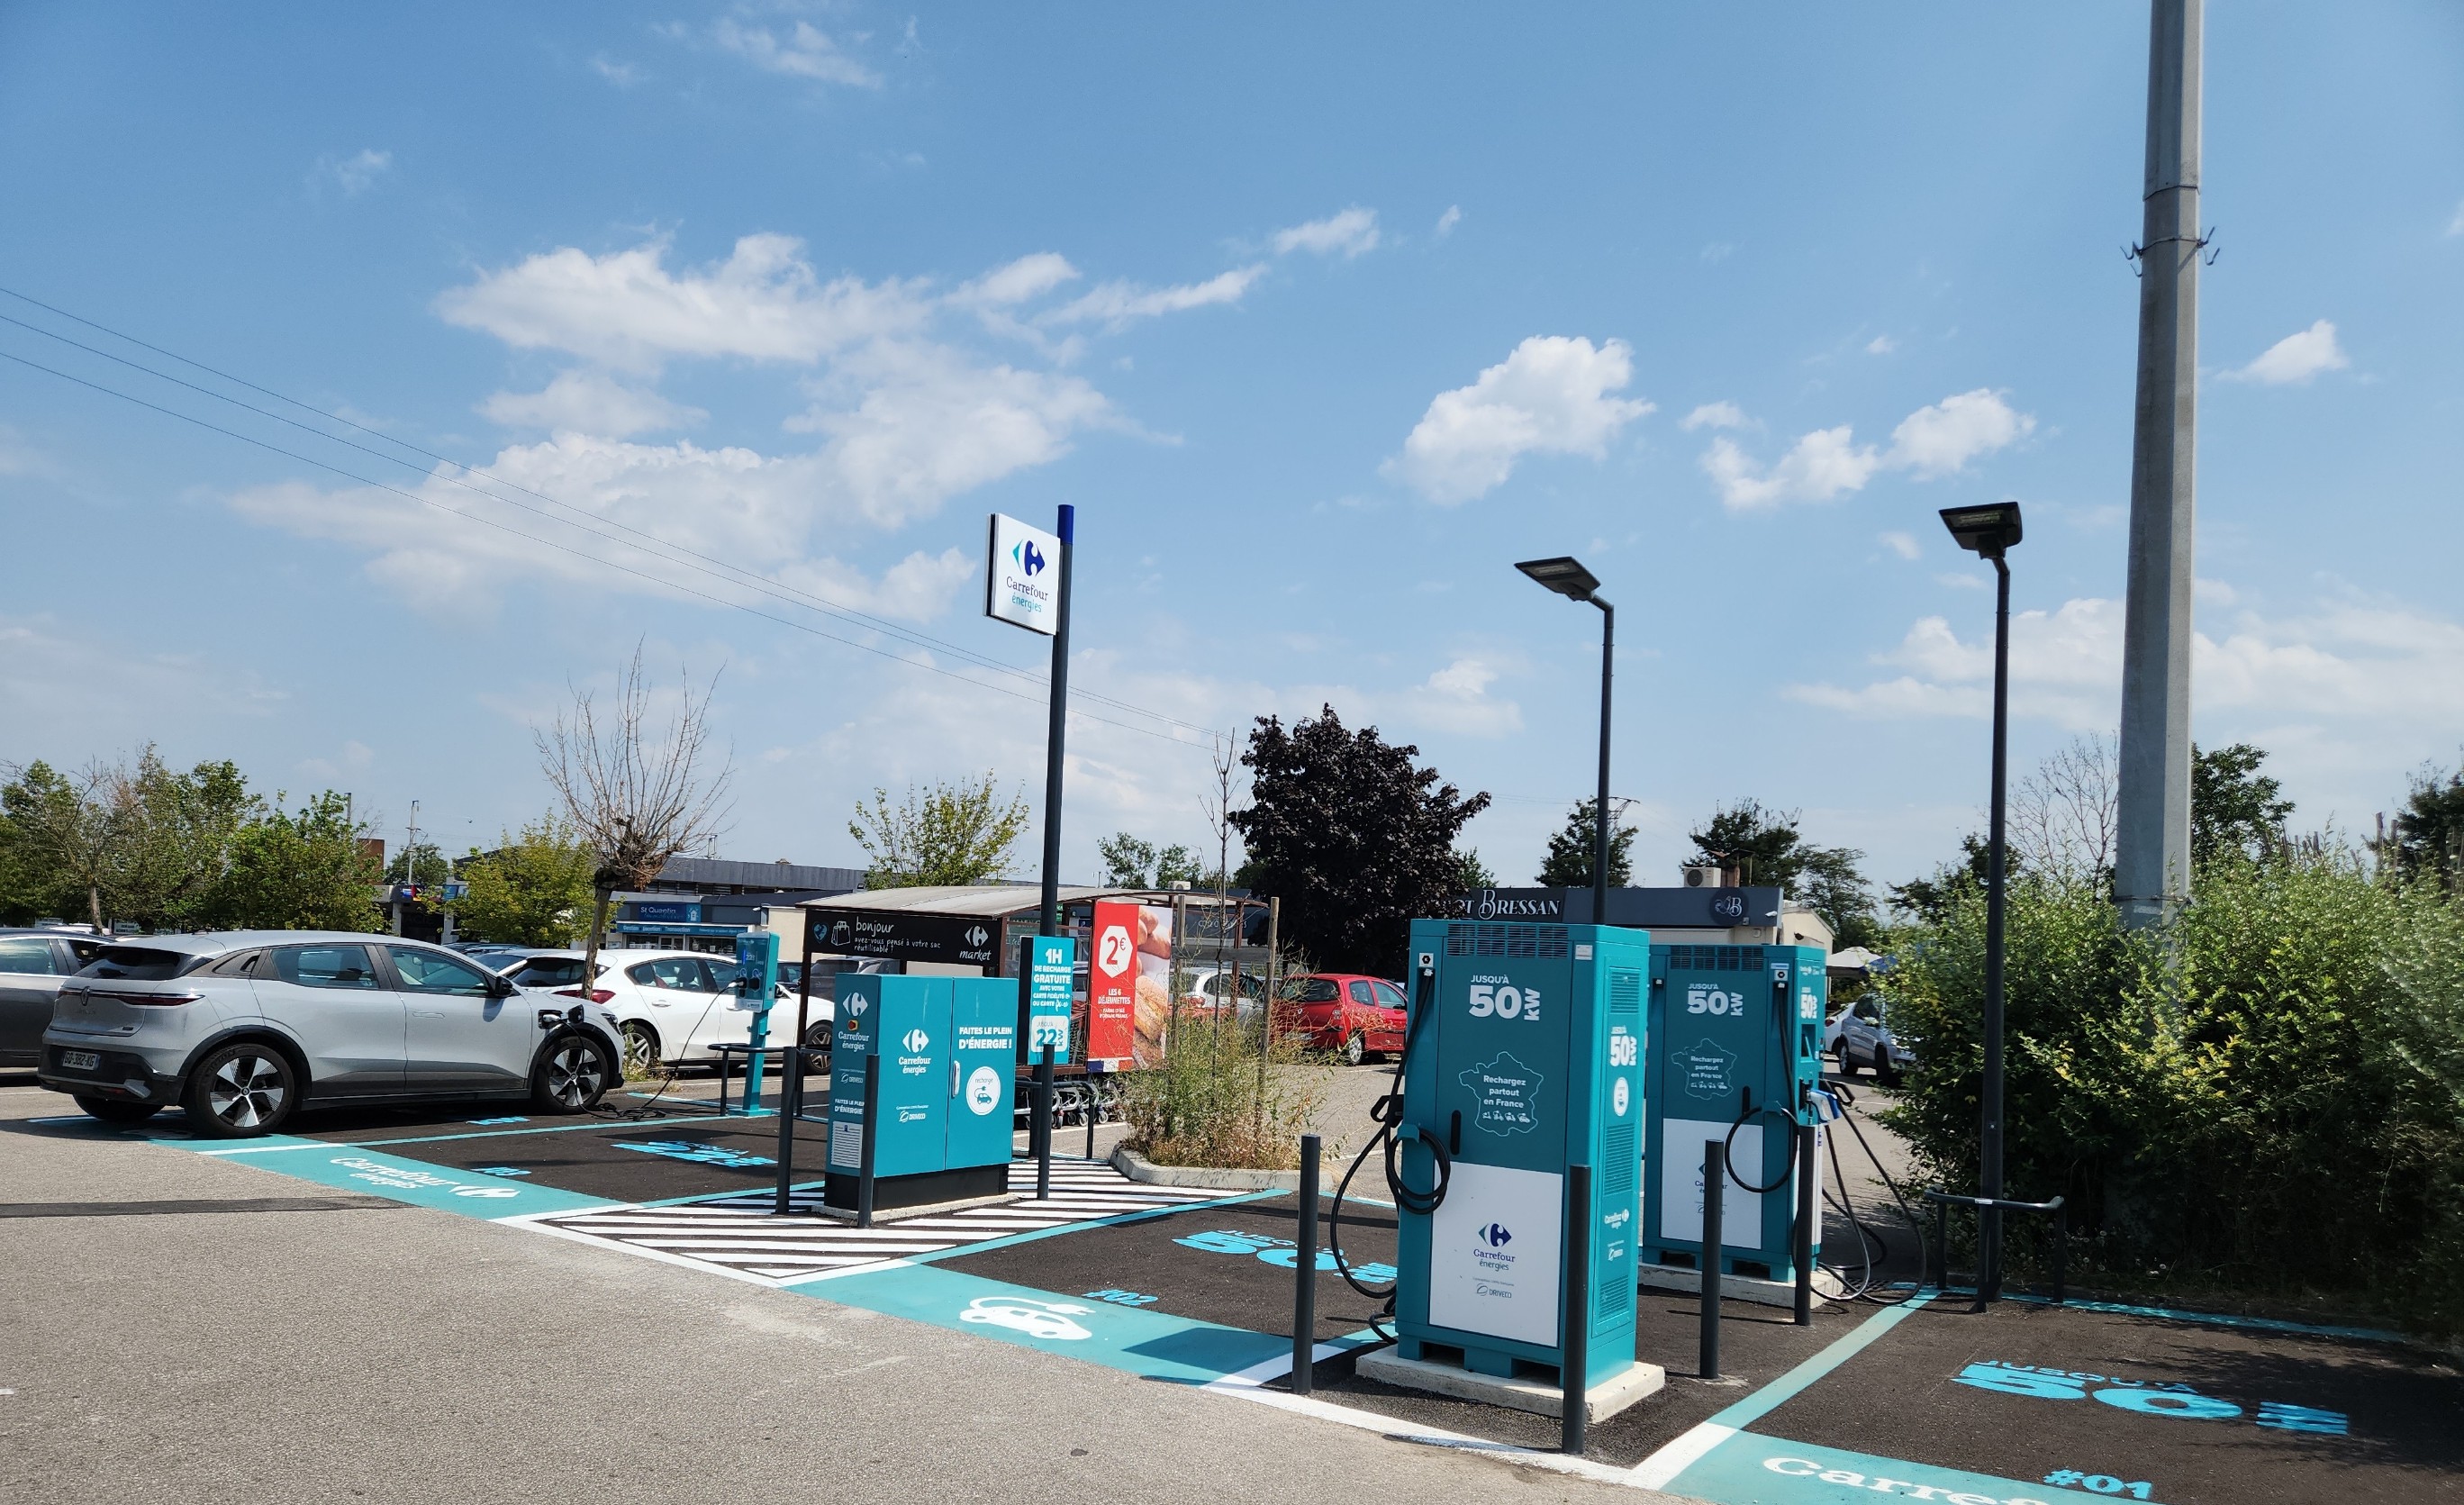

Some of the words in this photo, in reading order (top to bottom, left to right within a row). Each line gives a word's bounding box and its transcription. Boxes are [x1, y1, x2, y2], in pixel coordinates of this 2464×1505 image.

[1006, 576, 1049, 602] Carrefour
[1011, 592, 1043, 612] énergies
[648, 906, 676, 915] Quentin
[1478, 889, 1561, 920] BRESSAN
[856, 916, 894, 937] bonjour
[855, 937, 884, 946] avez-vous
[886, 938, 904, 947] pensé
[911, 939, 929, 948] votre
[959, 949, 992, 961] market
[1045, 948, 1063, 965] 1H
[1034, 965, 1042, 973] DE
[1042, 966, 1072, 974] RECHARGE
[1033, 974, 1071, 984] GRATUITE
[1471, 974, 1509, 984] JUSQU'À
[1108, 988, 1117, 996] LES
[1117, 988, 1122, 996] 6
[1468, 984, 1522, 1020] 50
[1524, 987, 1541, 1021] kW
[1687, 990, 1729, 1015] 50
[1730, 992, 1744, 1017] kW
[838, 1030, 870, 1043] Carrefour
[959, 1027, 983, 1035] FAITES
[983, 1027, 992, 1035] LE
[992, 1027, 1012, 1035] PLEIN
[958, 1037, 1007, 1049] D'ÉNERGIE
[1036, 1029, 1057, 1047] 22
[842, 1040, 865, 1052] énergies
[1610, 1035, 1630, 1067] 50
[898, 1056, 931, 1065] Carrefour
[1690, 1056, 1724, 1064] Rechargez
[902, 1065, 927, 1075] énergies
[1700, 1072, 1723, 1080] France
[974, 1077, 993, 1085] recharge
[1483, 1074, 1526, 1087] Rechargez
[1489, 1087, 1519, 1097] partout
[1495, 1098, 1524, 1109] France
[330, 1157, 461, 1186] Carrefour
[1172, 1230, 1349, 1271] 50
[1473, 1248, 1516, 1263] Carrefour
[1479, 1258, 1509, 1272] énergies
[1082, 1289, 1159, 1306] #02
[1490, 1288, 1512, 1299] DRIVECO
[1950, 1363, 2242, 1419] 50
[2043, 1467, 2152, 1500] #01
